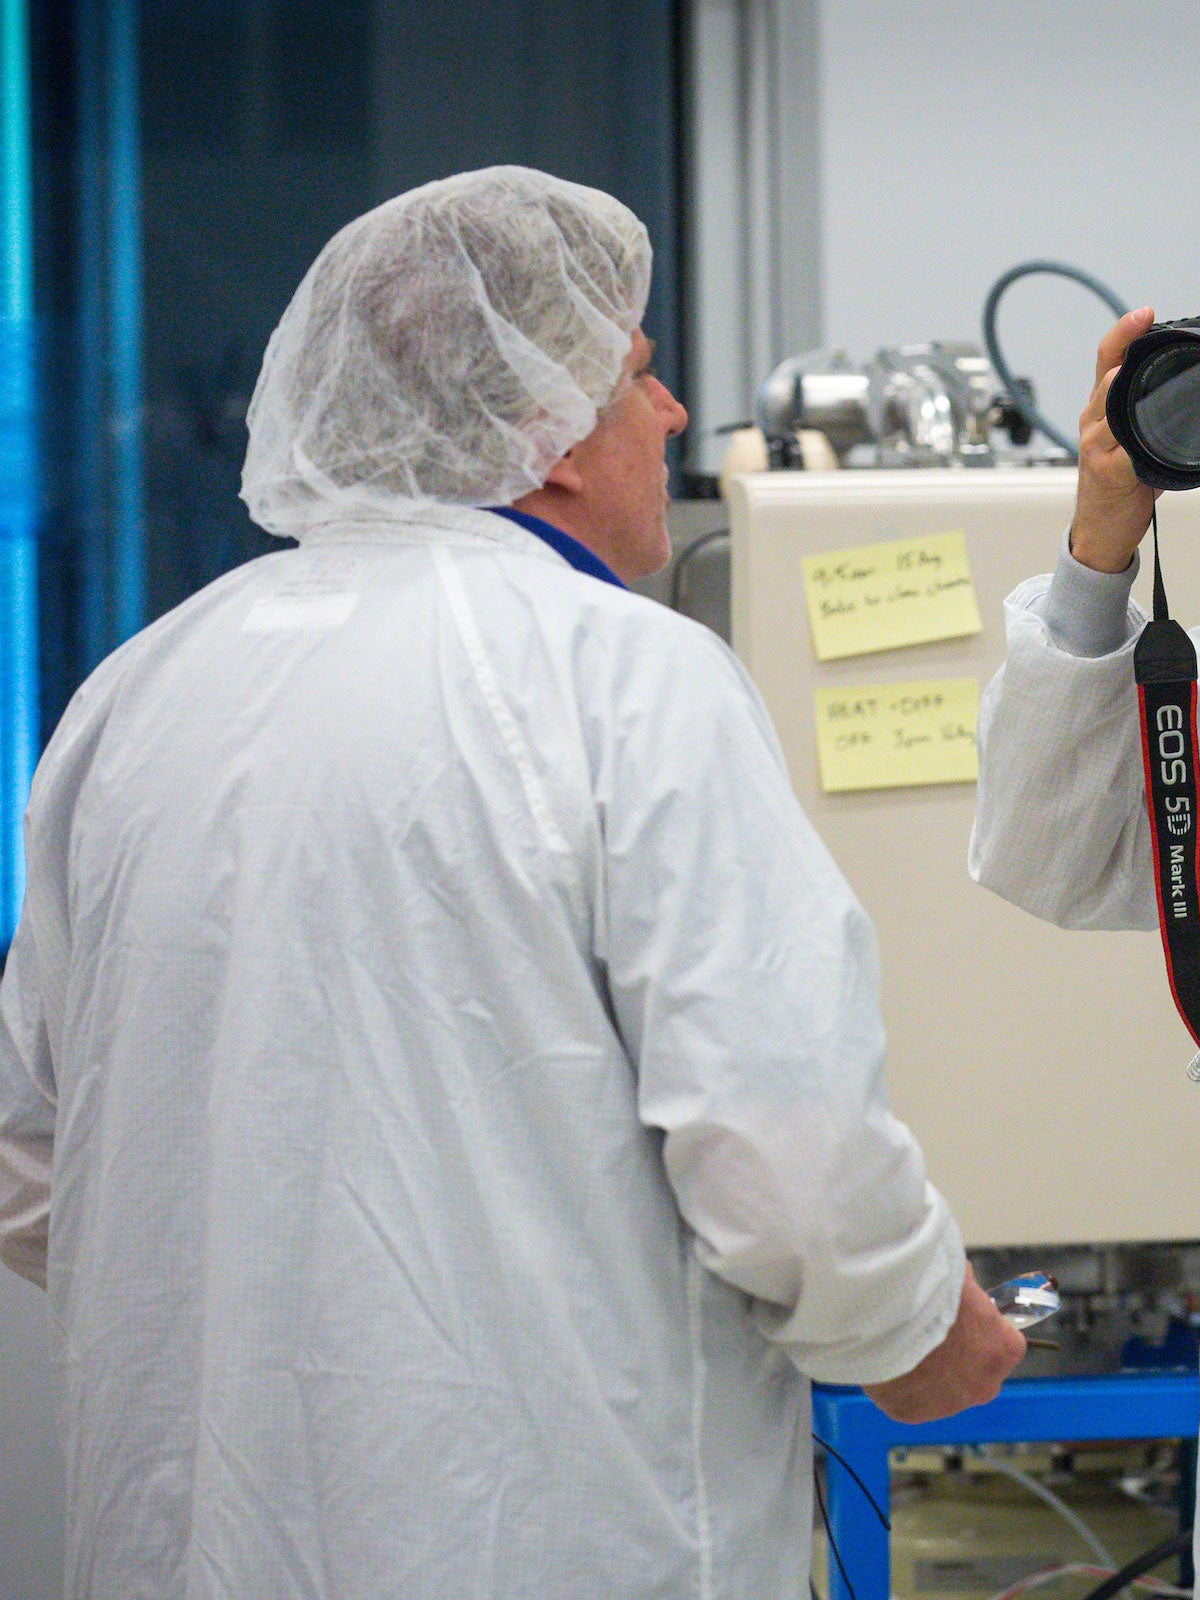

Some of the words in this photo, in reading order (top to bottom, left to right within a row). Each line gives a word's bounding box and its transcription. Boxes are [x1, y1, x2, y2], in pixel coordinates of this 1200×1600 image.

[1156, 704, 1188, 786] EOS
[1165, 796, 1192, 836] 5D
[1169, 845, 1186, 897] Mark
